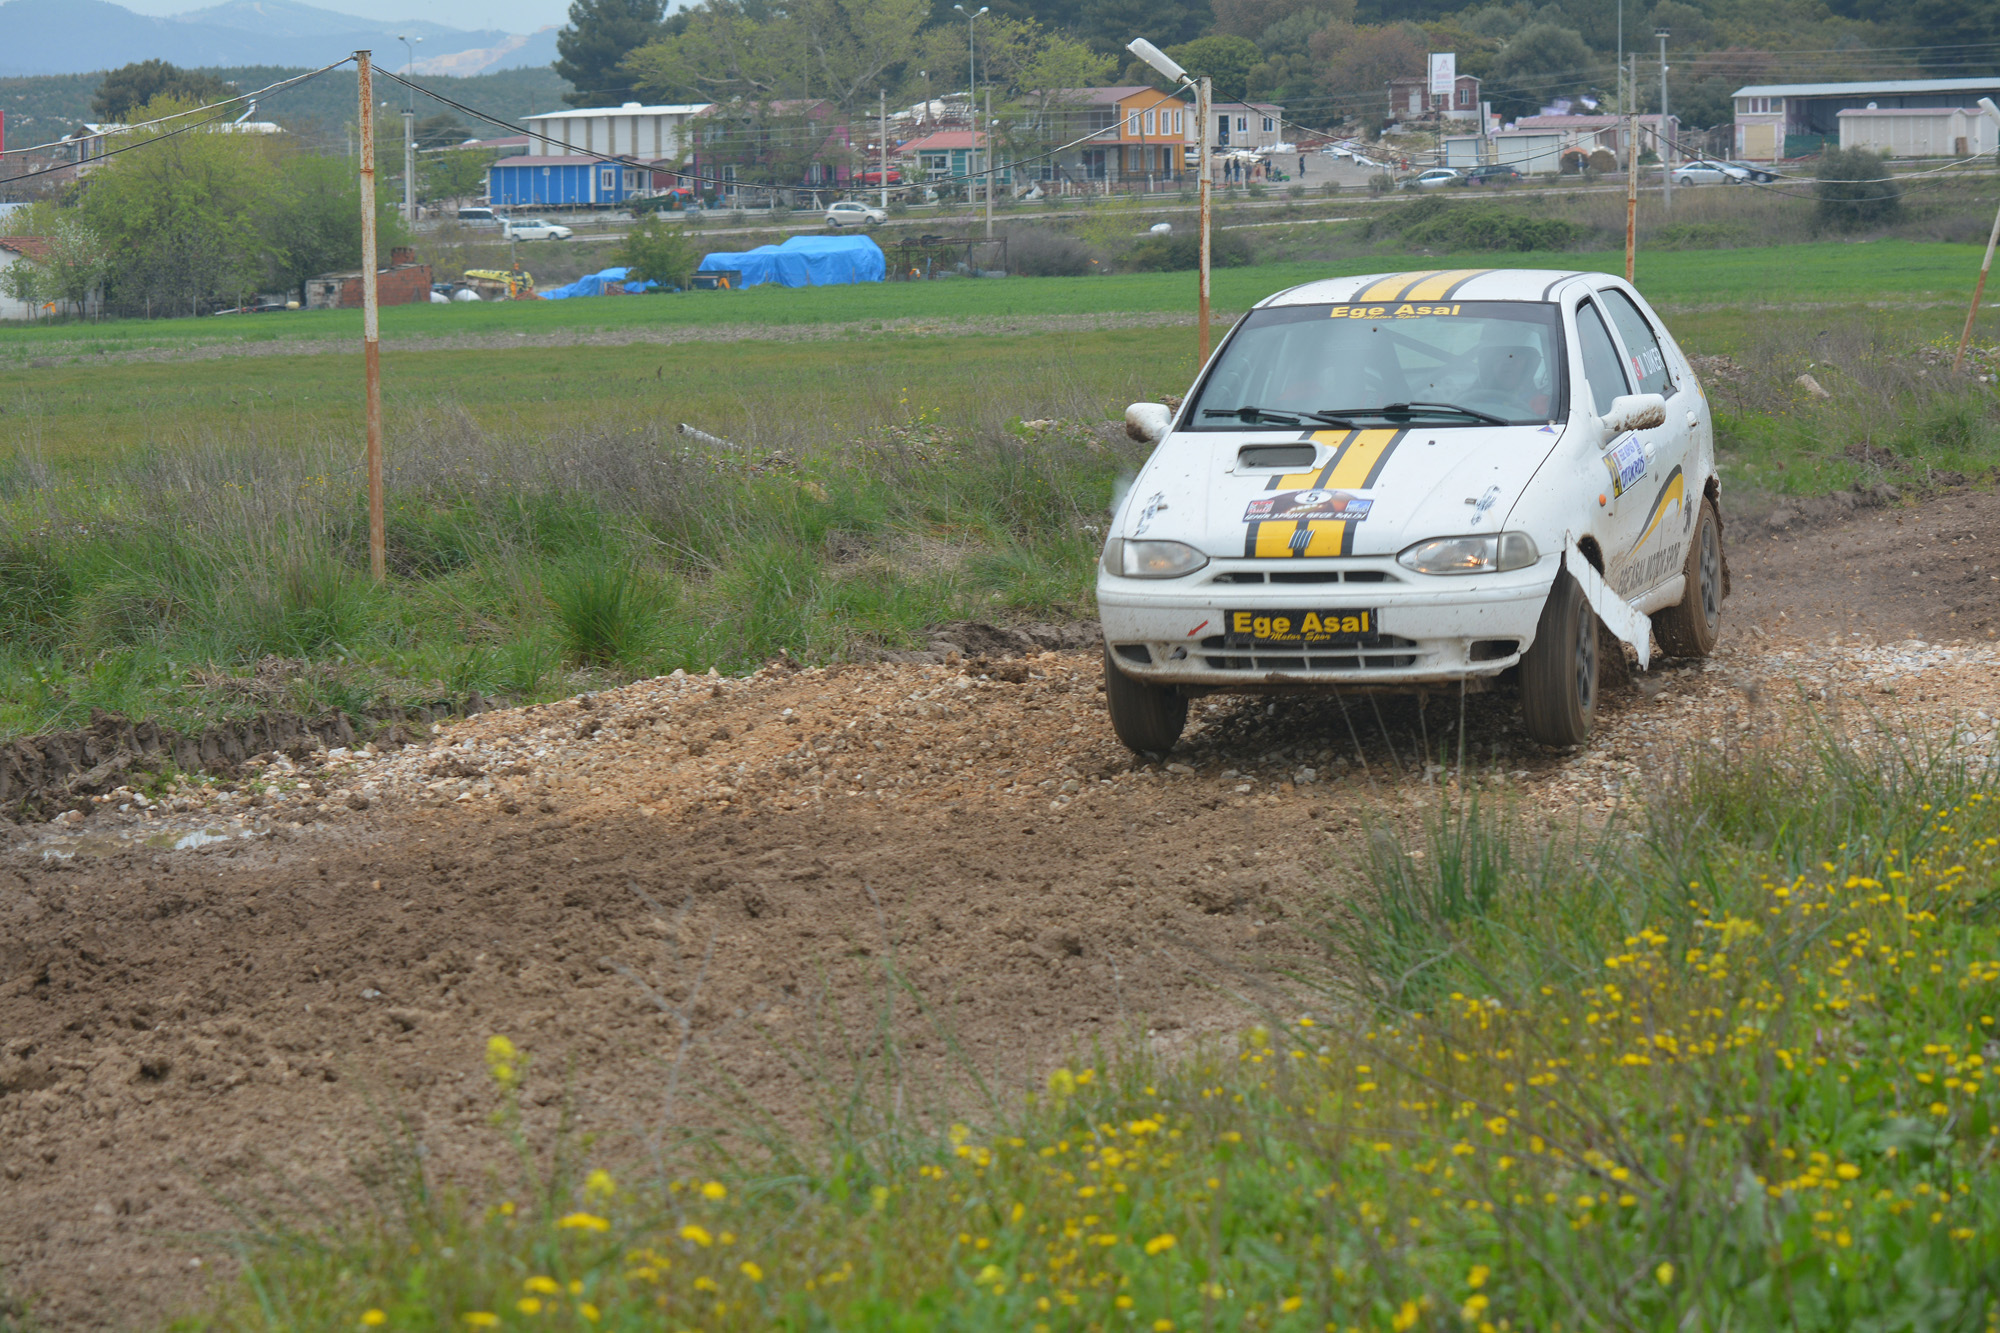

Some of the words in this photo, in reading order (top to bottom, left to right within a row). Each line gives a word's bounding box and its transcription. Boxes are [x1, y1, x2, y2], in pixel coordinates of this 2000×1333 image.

[1330, 306, 1385, 319] Ege
[1394, 304, 1461, 316] Asal
[1306, 491, 1319, 502] 5
[1233, 612, 1290, 638] Ege
[1300, 611, 1369, 633] Asal
[1270, 632, 1301, 641] Motor
[1305, 631, 1331, 643] Spor
